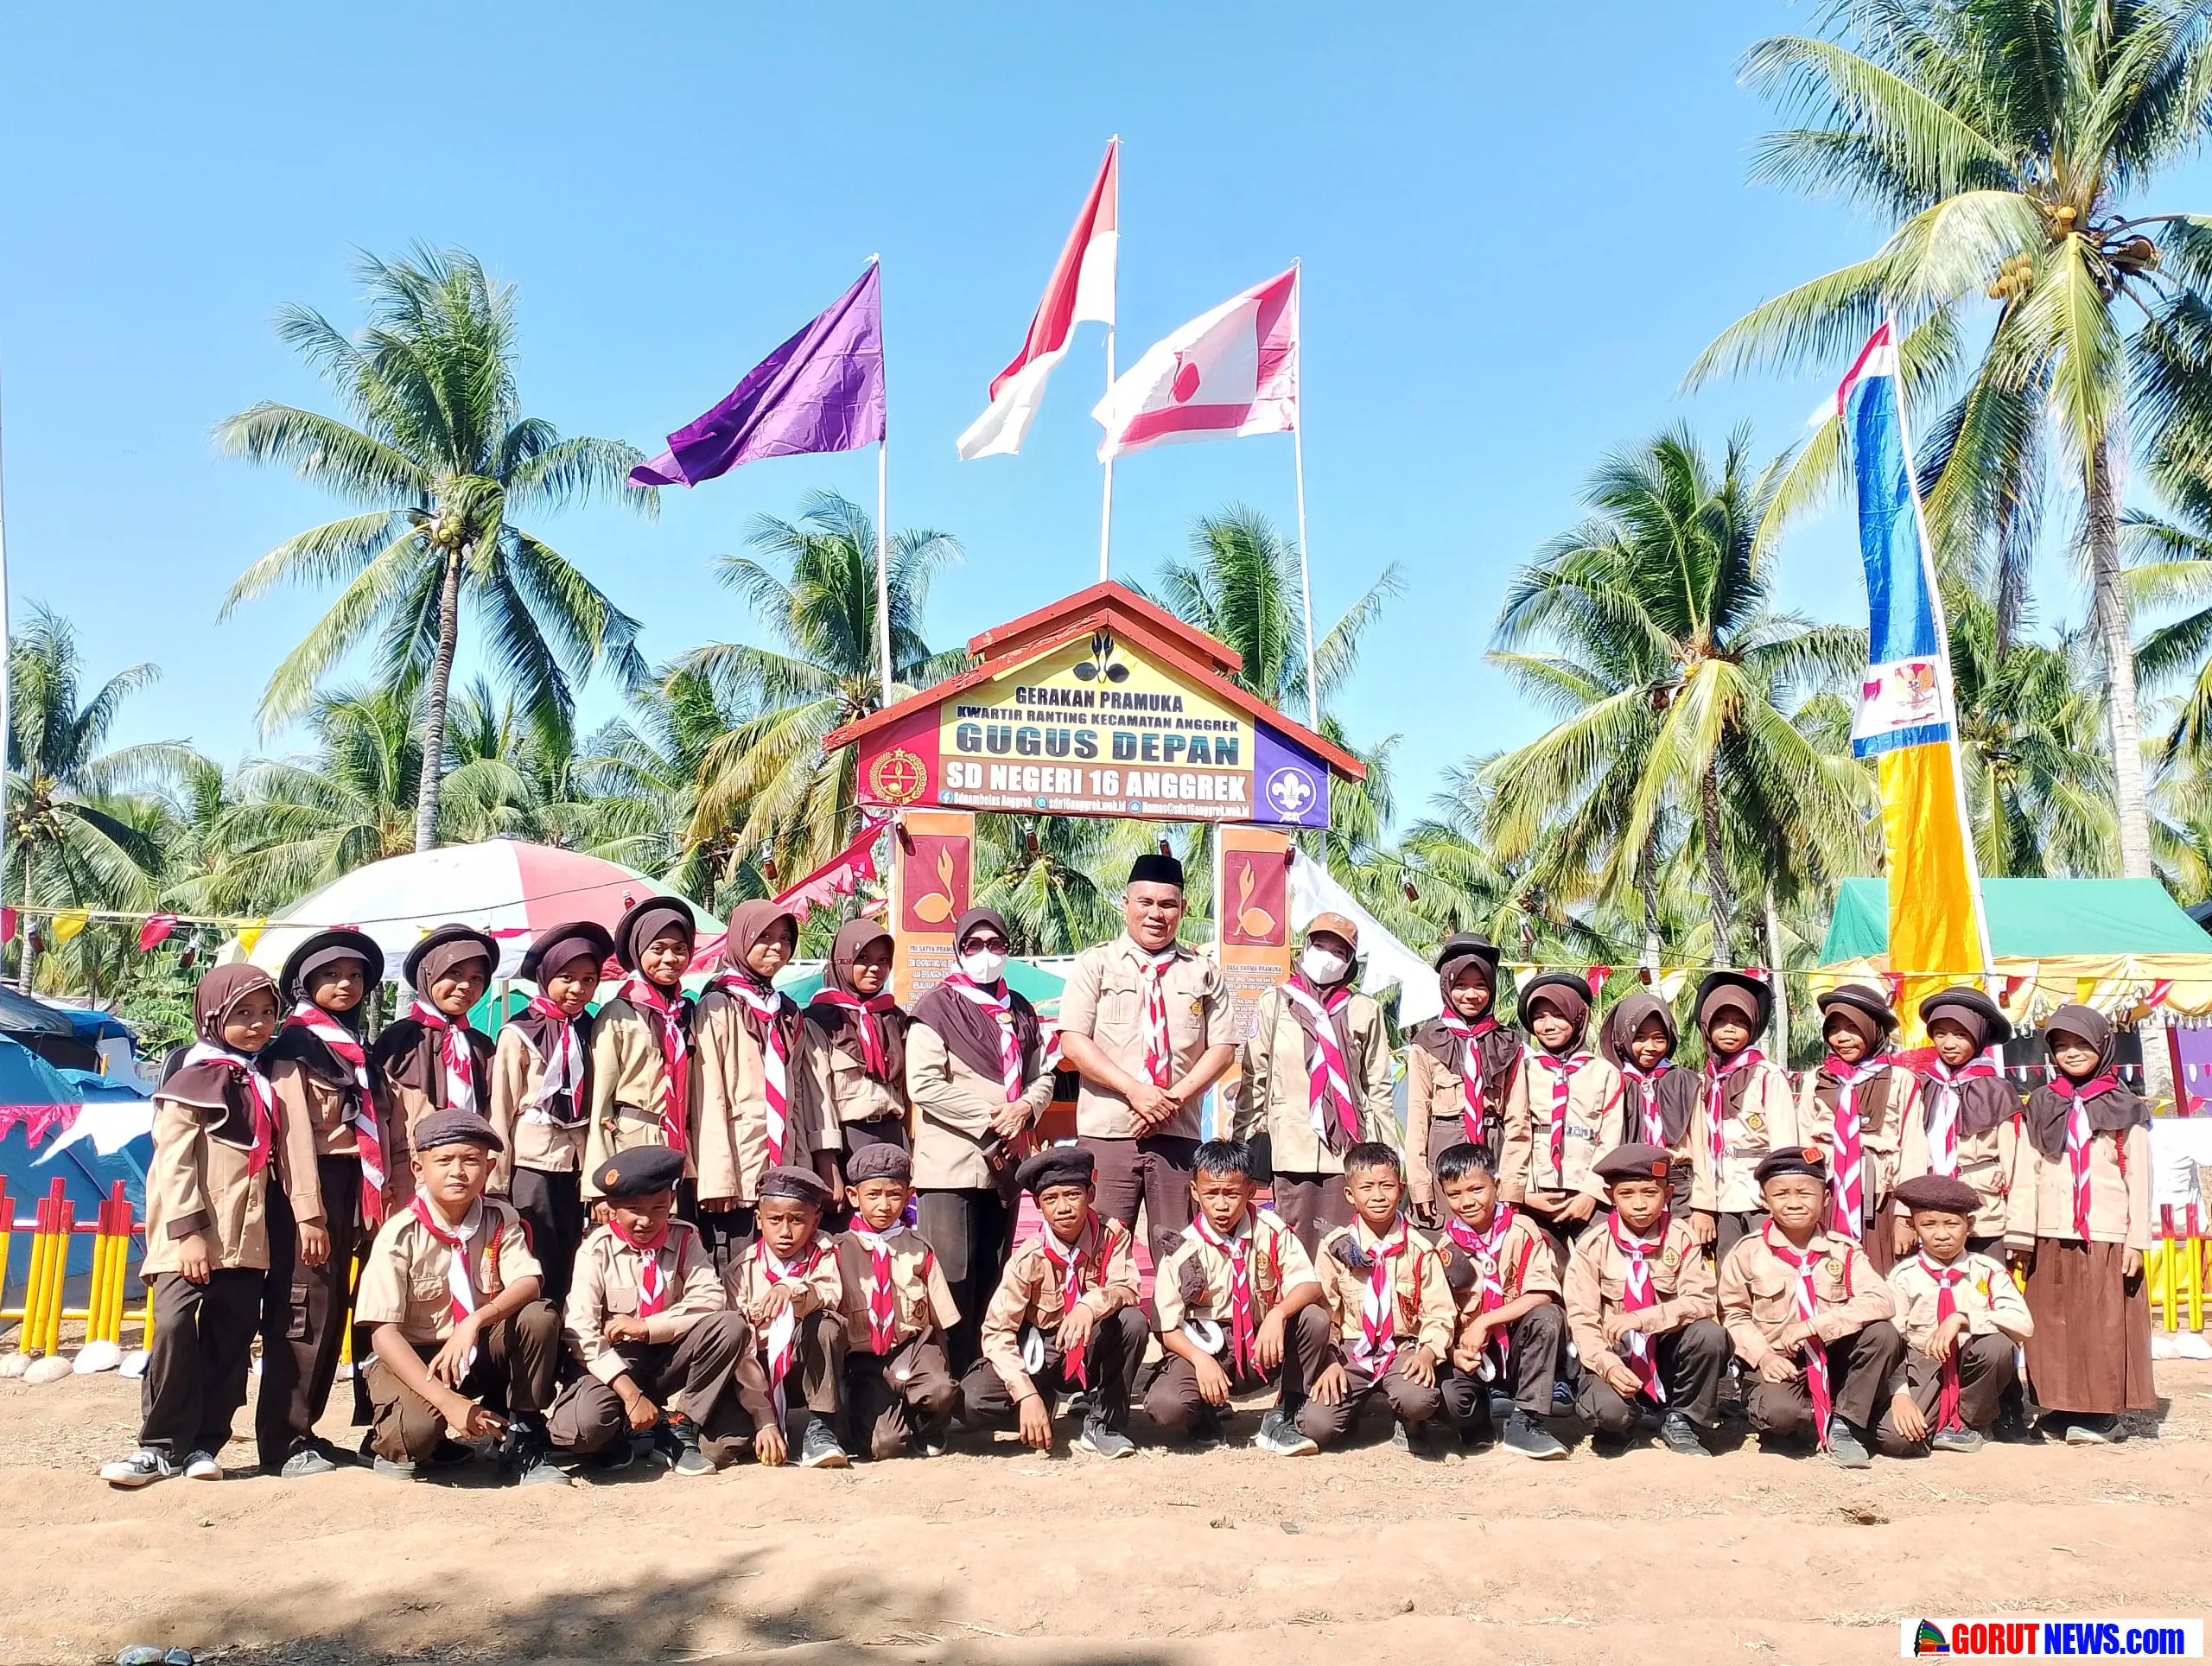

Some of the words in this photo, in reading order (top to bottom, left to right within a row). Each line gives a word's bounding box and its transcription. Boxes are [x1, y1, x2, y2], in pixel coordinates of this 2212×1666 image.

[1015, 686, 1095, 709] GERAKAN
[1100, 690, 1184, 713] PRAMUKA
[957, 705, 1023, 721] KWARTIR
[1027, 709, 1088, 725] RANTING
[1091, 713, 1172, 729] KECAMATAN
[1175, 717, 1239, 733] ANGGREK
[956, 722, 1099, 760] GUGUS
[1112, 731, 1239, 766] DEPAN
[946, 761, 983, 790] SD
[989, 764, 1084, 795] NEGERI
[1088, 769, 1121, 797] 16
[1125, 771, 1247, 803] ANGGREK
[1001, 794, 1033, 809] Anggrek
